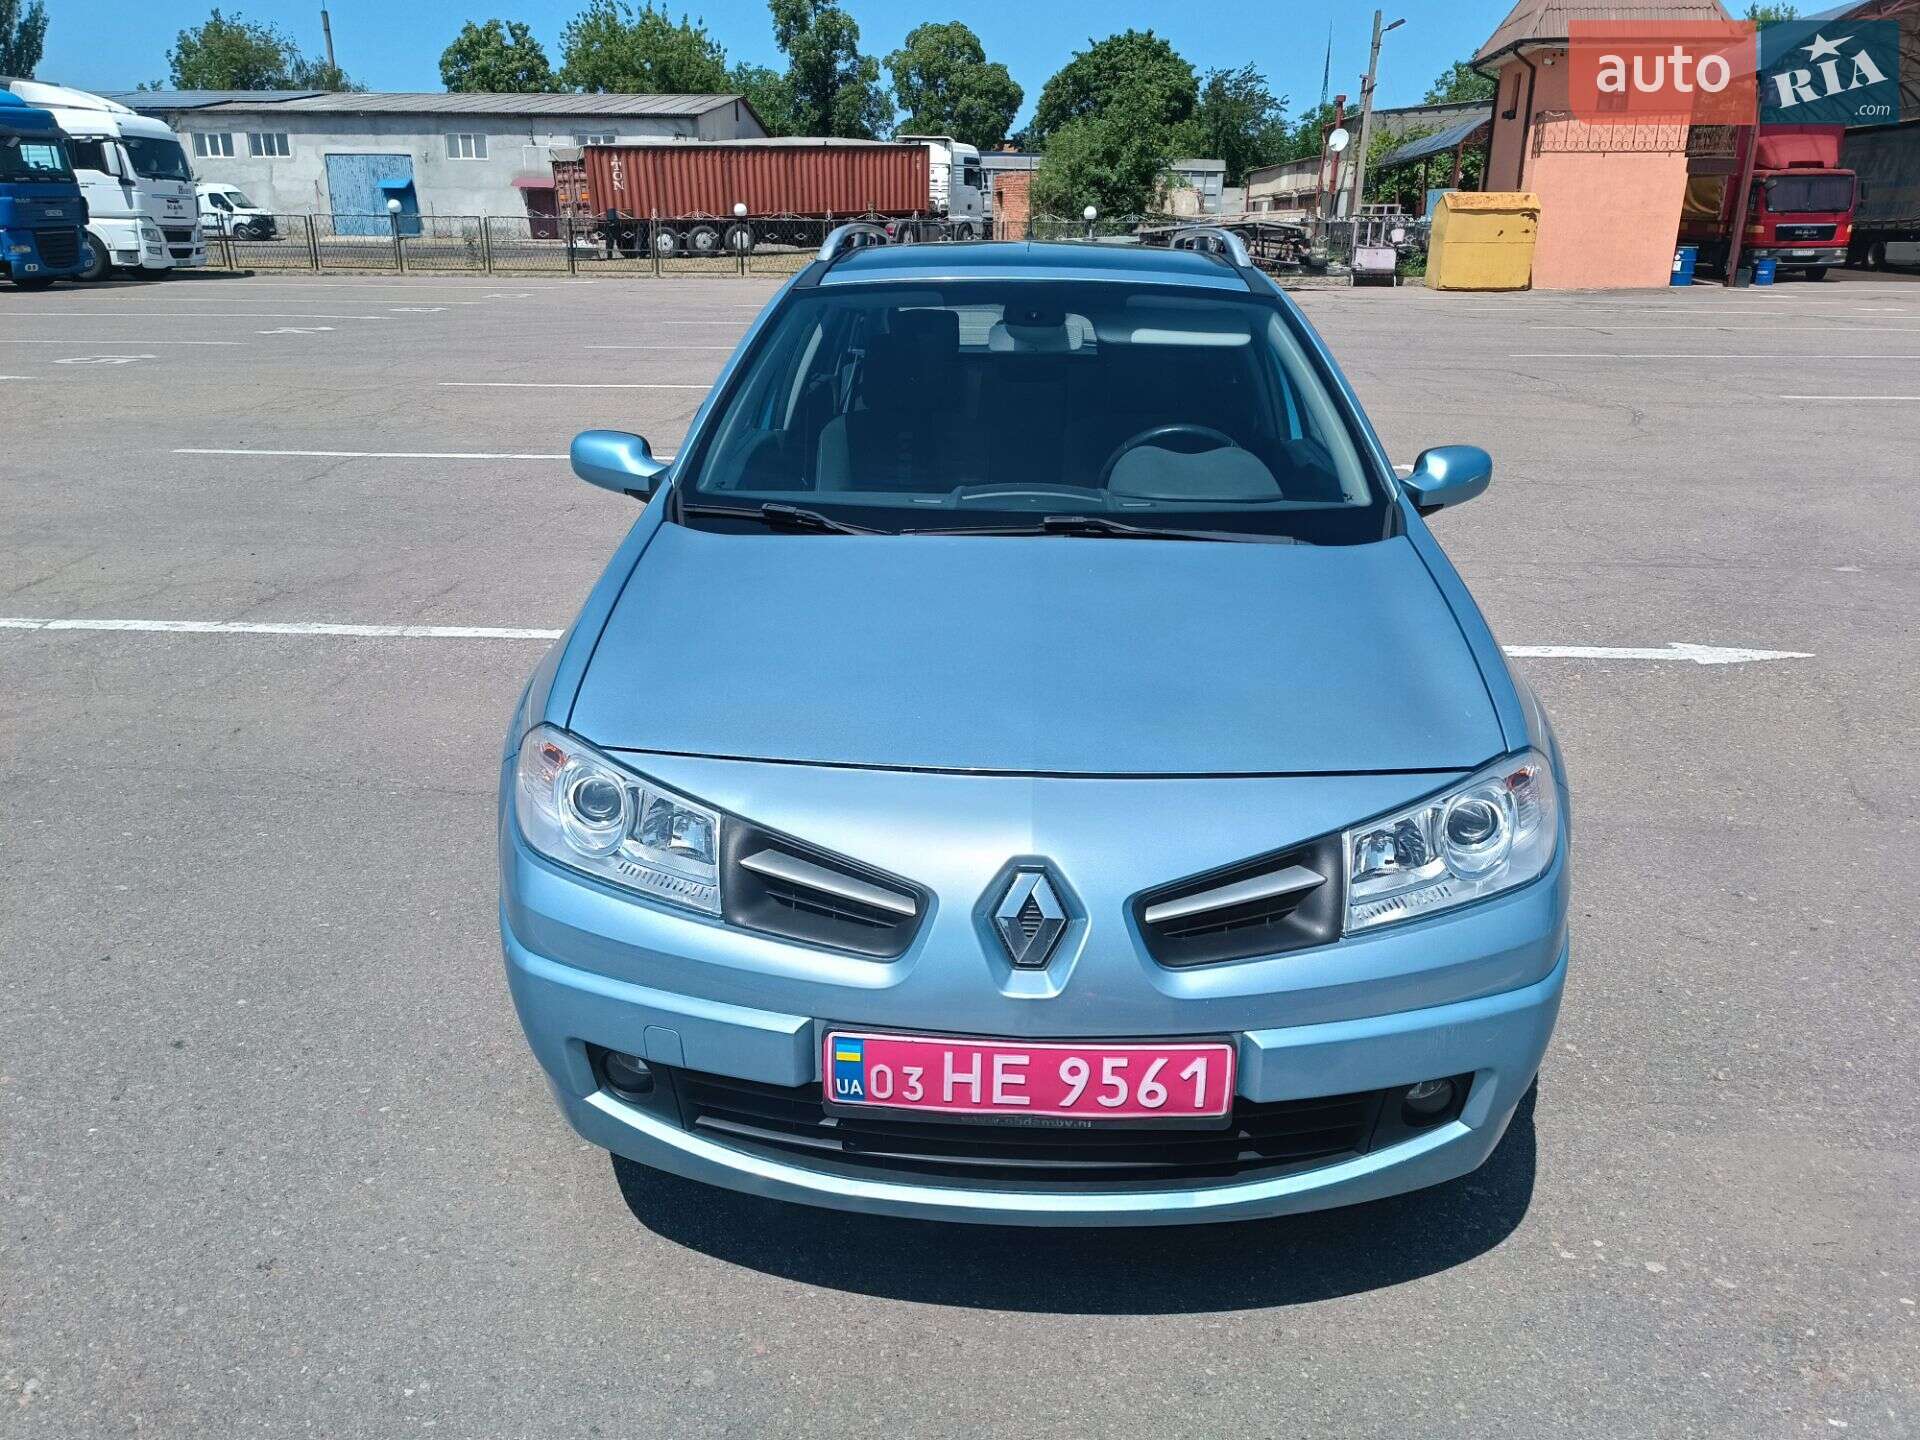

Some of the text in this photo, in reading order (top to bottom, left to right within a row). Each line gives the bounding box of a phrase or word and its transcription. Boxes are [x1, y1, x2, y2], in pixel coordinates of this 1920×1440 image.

[837, 1079, 863, 1096] UA
[870, 1051, 1208, 1109] 03 HE 9561
